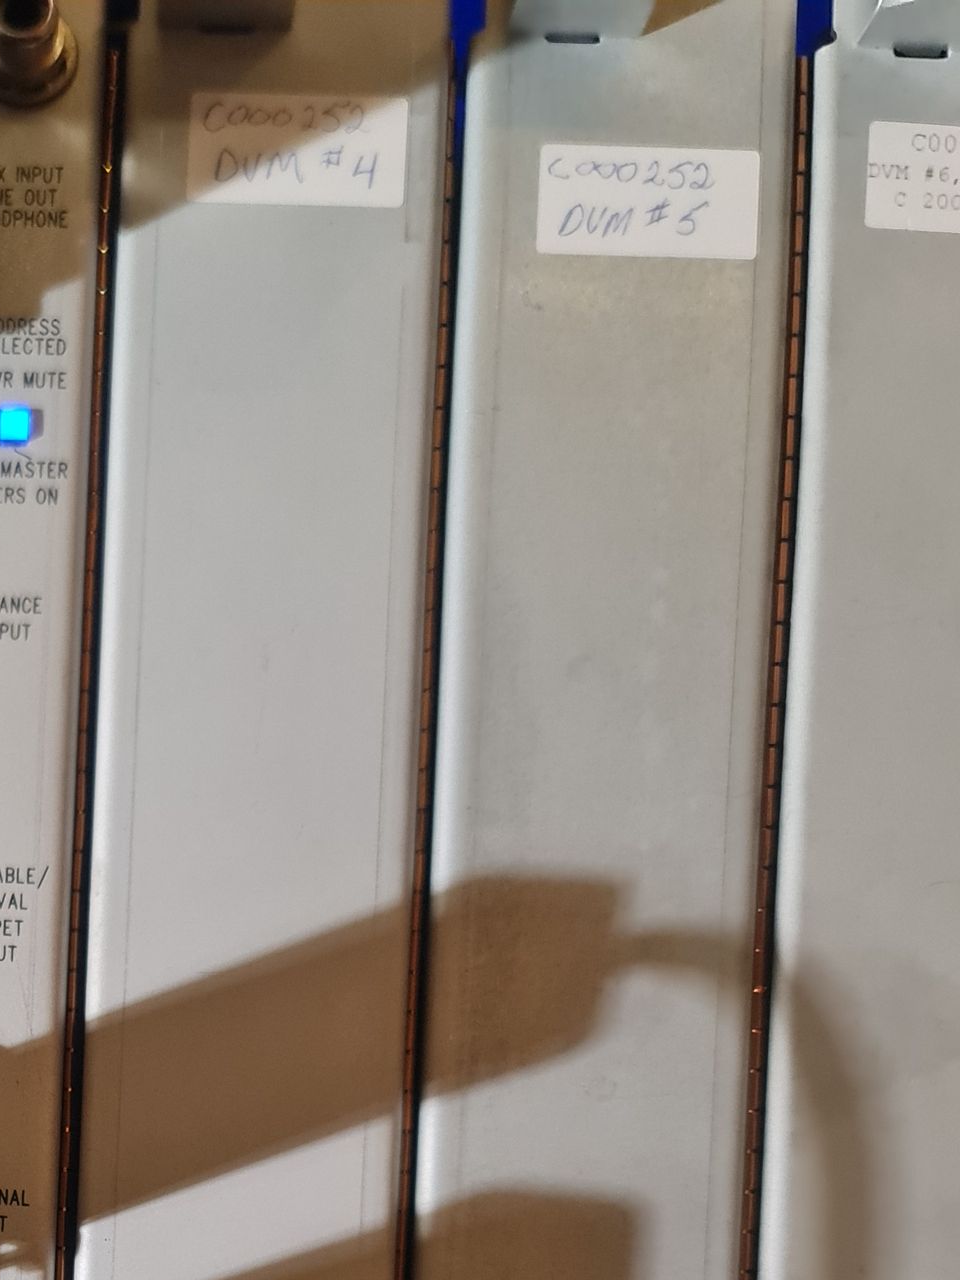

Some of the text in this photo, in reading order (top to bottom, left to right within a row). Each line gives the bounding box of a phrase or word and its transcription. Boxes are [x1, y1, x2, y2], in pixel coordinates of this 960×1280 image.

[911, 133, 960, 154] C00
[15, 166, 64, 184] INPUT
[214, 148, 304, 184] DVM
[868, 163, 960, 185] DVM #6,
[24, 188, 58, 207] OUT
[923, 192, 960, 211] 200
[558, 203, 634, 238] DVM
[23, 371, 67, 390] MUTE
[0, 460, 69, 480] MASTER
[35, 488, 58, 505] ON
